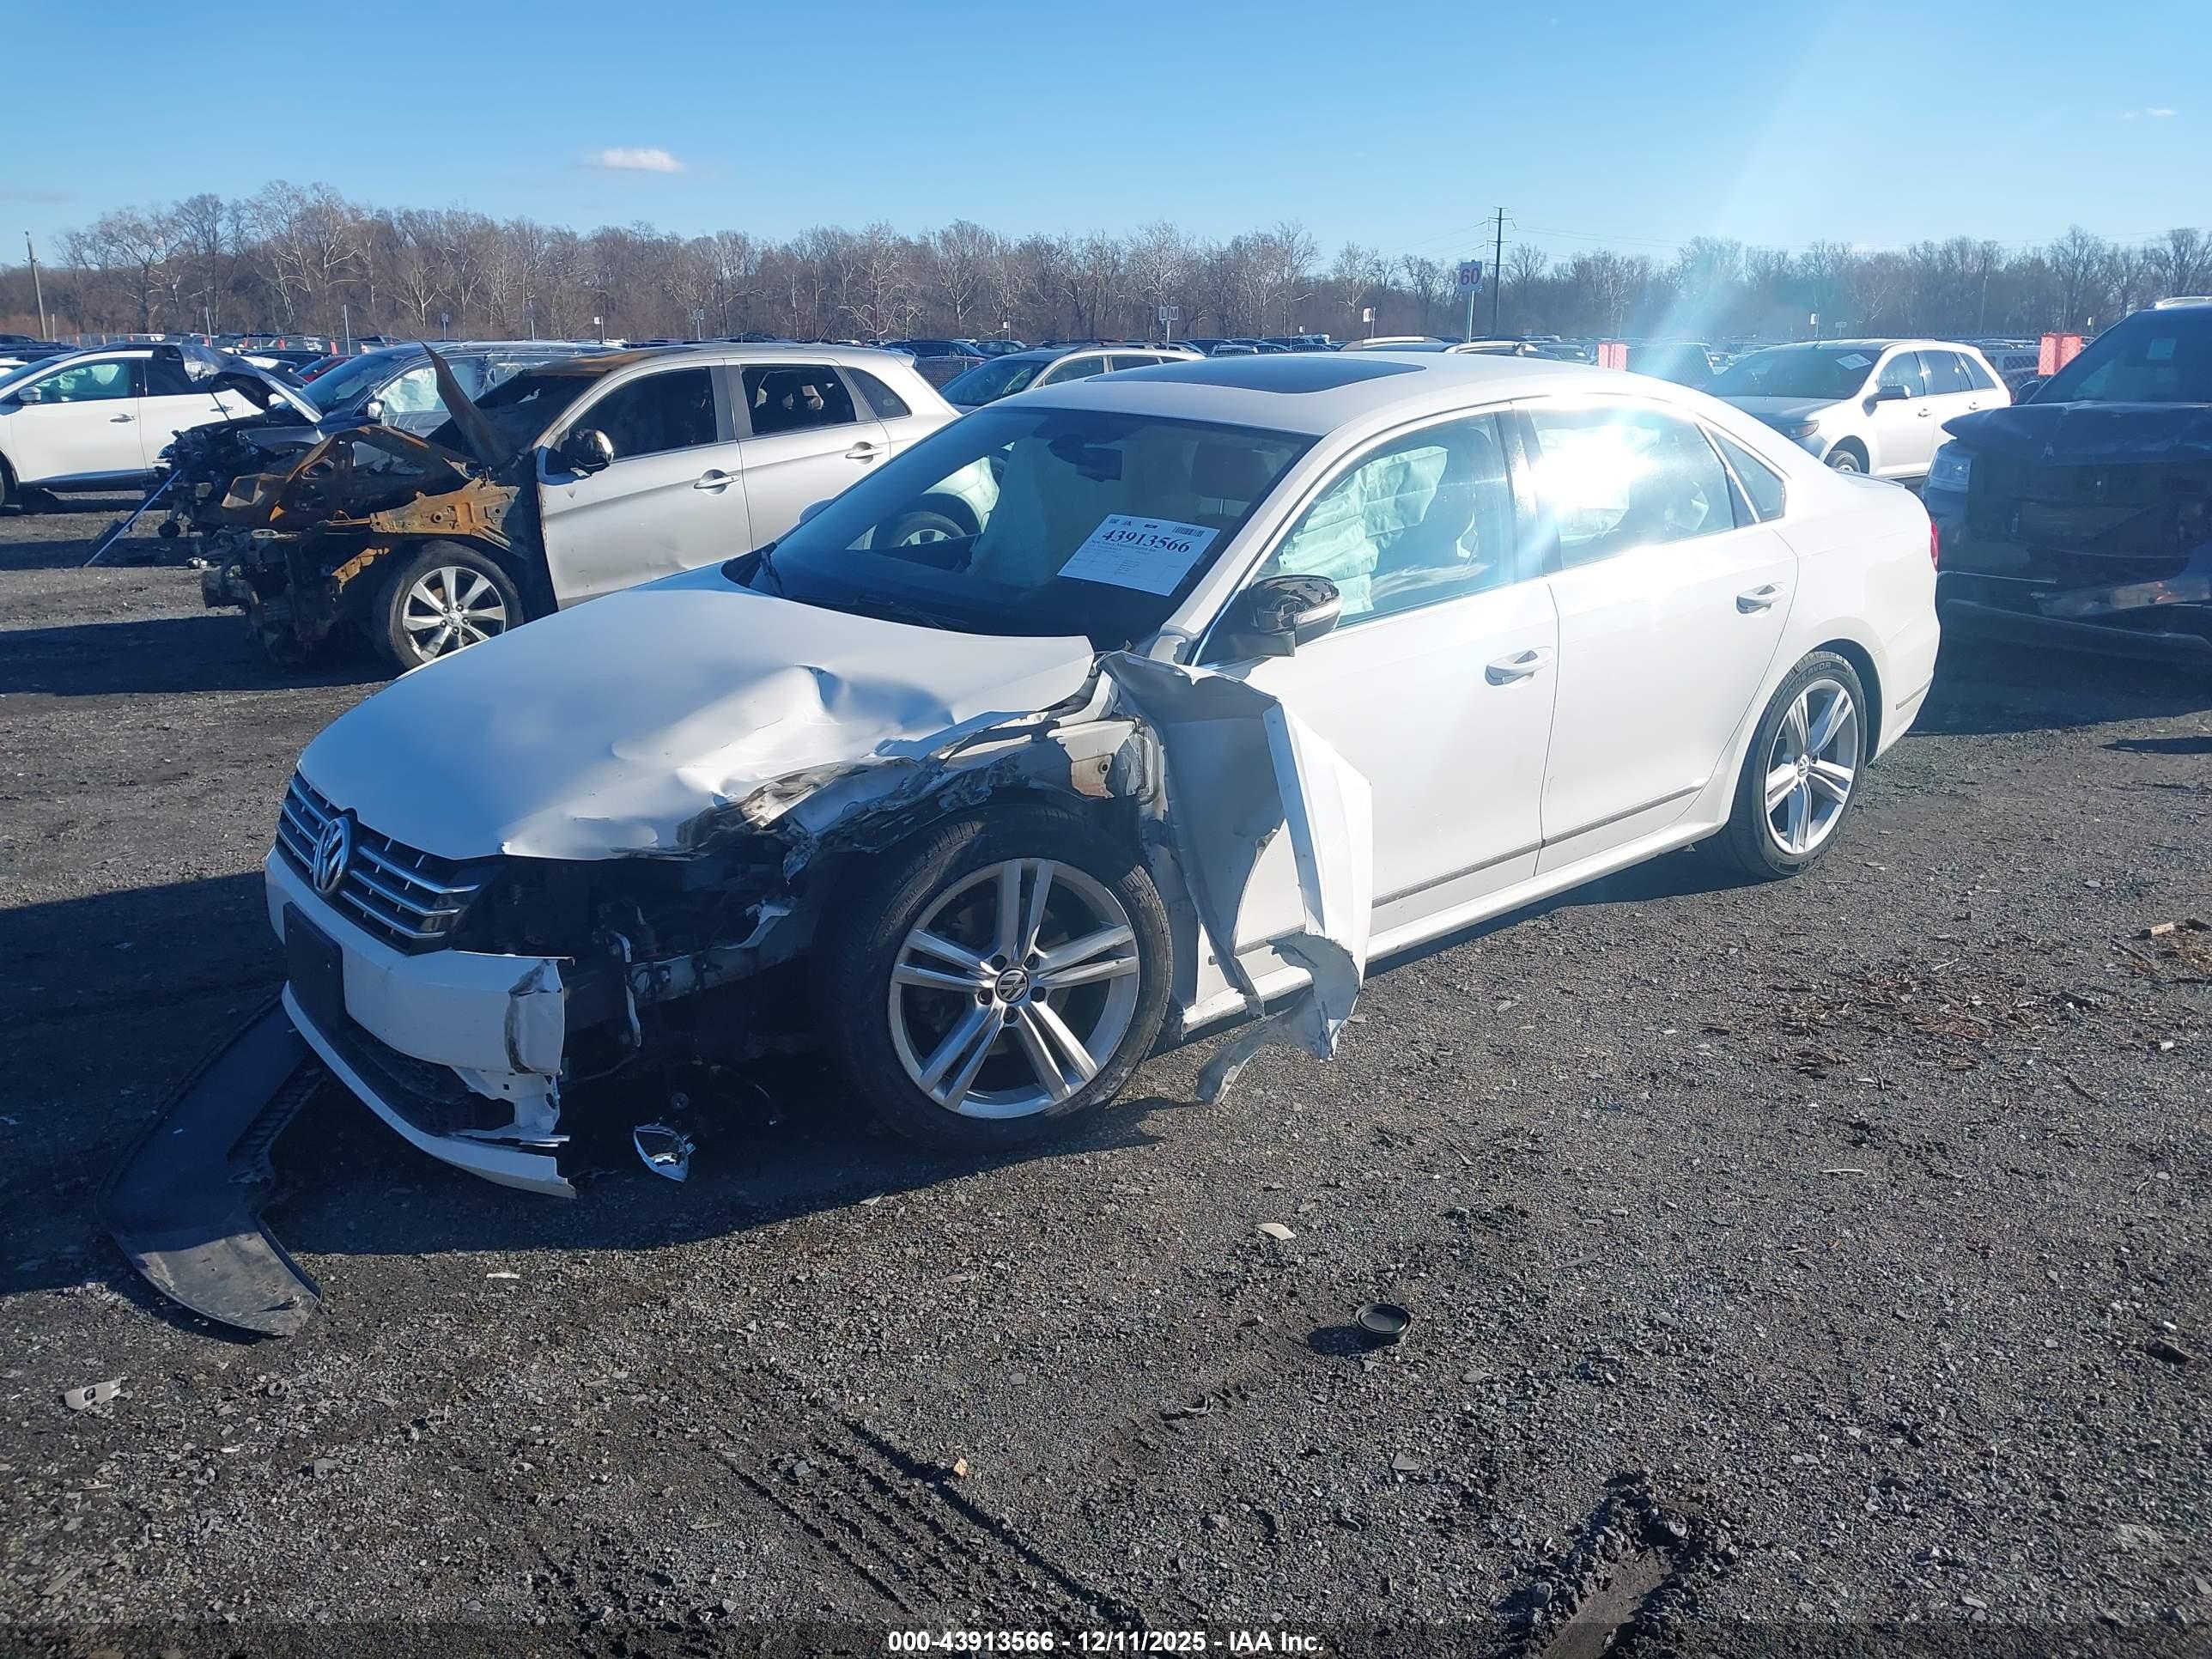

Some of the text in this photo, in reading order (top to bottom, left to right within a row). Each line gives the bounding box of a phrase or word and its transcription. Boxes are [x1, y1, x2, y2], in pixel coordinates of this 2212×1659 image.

[1461, 267, 1481, 285] 60
[1102, 529, 1194, 554] 43913566
[313, 817, 350, 894] VW
